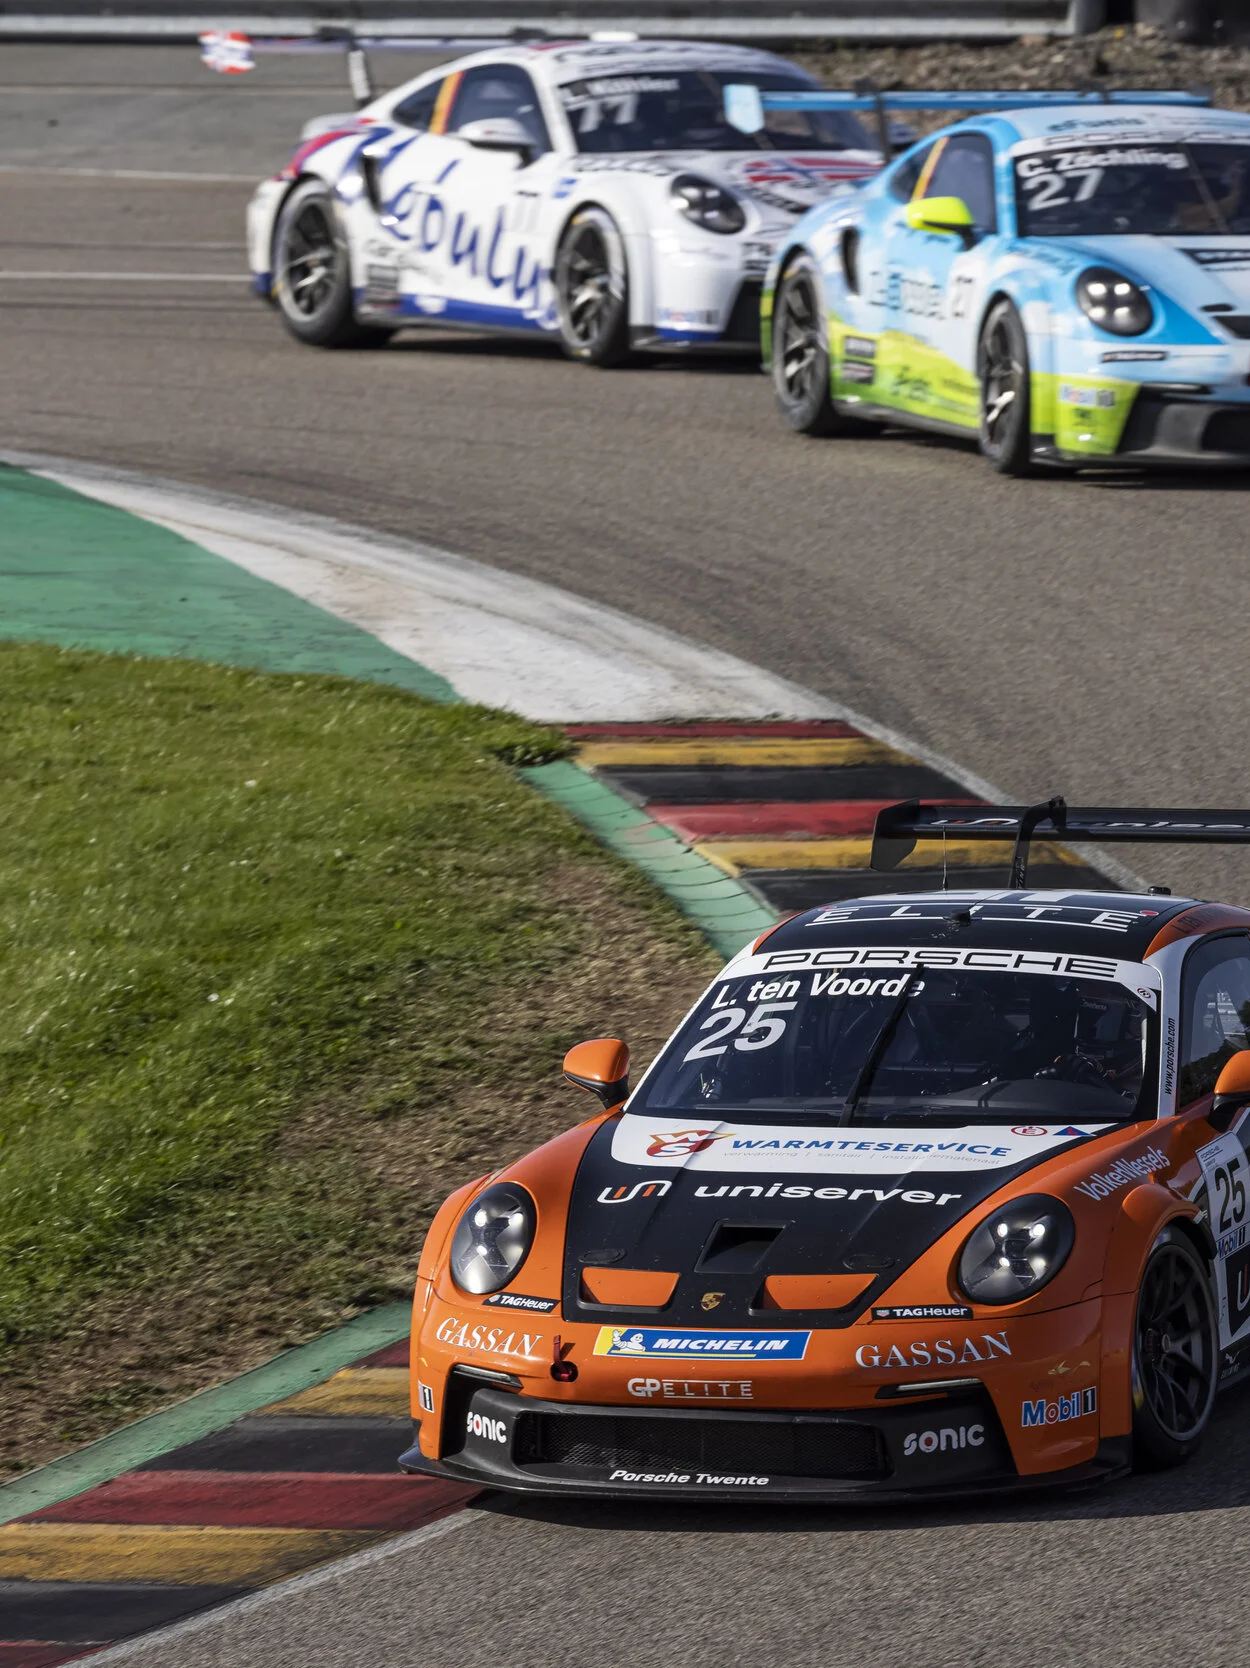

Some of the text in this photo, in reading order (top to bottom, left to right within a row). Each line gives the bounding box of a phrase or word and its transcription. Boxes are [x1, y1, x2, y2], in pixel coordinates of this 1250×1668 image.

[1016, 157, 1051, 178] C.
[1022, 168, 1105, 211] 27
[762, 950, 1118, 978] PORSCHE
[711, 985, 734, 1010] L.
[748, 978, 799, 1002] ten
[683, 1001, 797, 1063] 25
[1164, 1017, 1176, 1096] www.porsche.com
[731, 1139, 1012, 1157] WARMTESERVICE
[1073, 1146, 1171, 1201] VolkerWessels
[694, 1182, 963, 1206] uniserver
[1214, 1158, 1246, 1233] 25
[500, 1295, 554, 1310] TAGHeuer
[893, 1306, 968, 1317] TAGHeuer
[435, 1316, 544, 1356] GASSAN
[652, 1338, 790, 1351] MICHELIN
[855, 1330, 1013, 1369] GASSAN
[1021, 1391, 1081, 1428] Mobil
[609, 1470, 770, 1485] Porsche Twente
